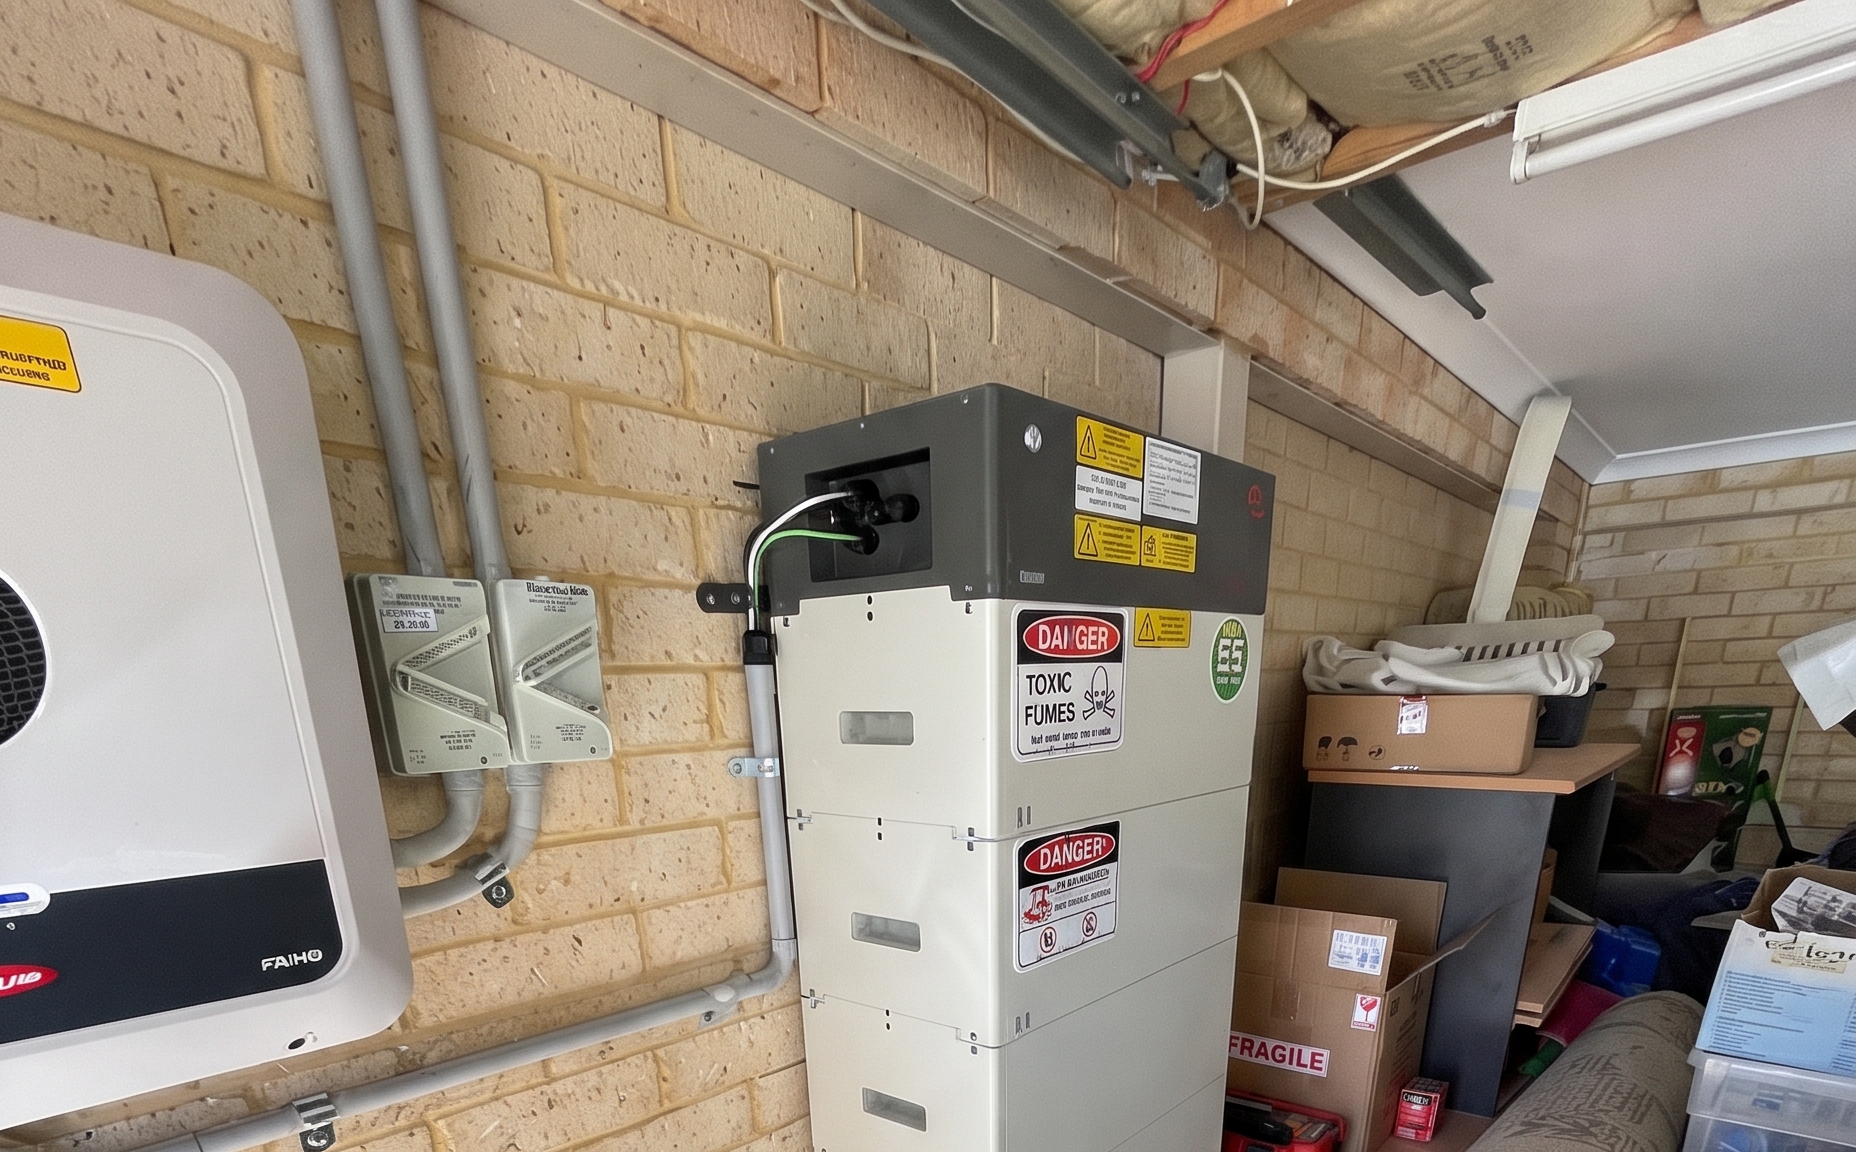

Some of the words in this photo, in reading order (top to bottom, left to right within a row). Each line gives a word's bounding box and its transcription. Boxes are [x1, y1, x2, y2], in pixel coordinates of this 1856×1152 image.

[1026, 671, 1072, 696] TOXIC
[1025, 702, 1076, 726] FUMES
[1229, 1034, 1325, 1072] FRAGILE
